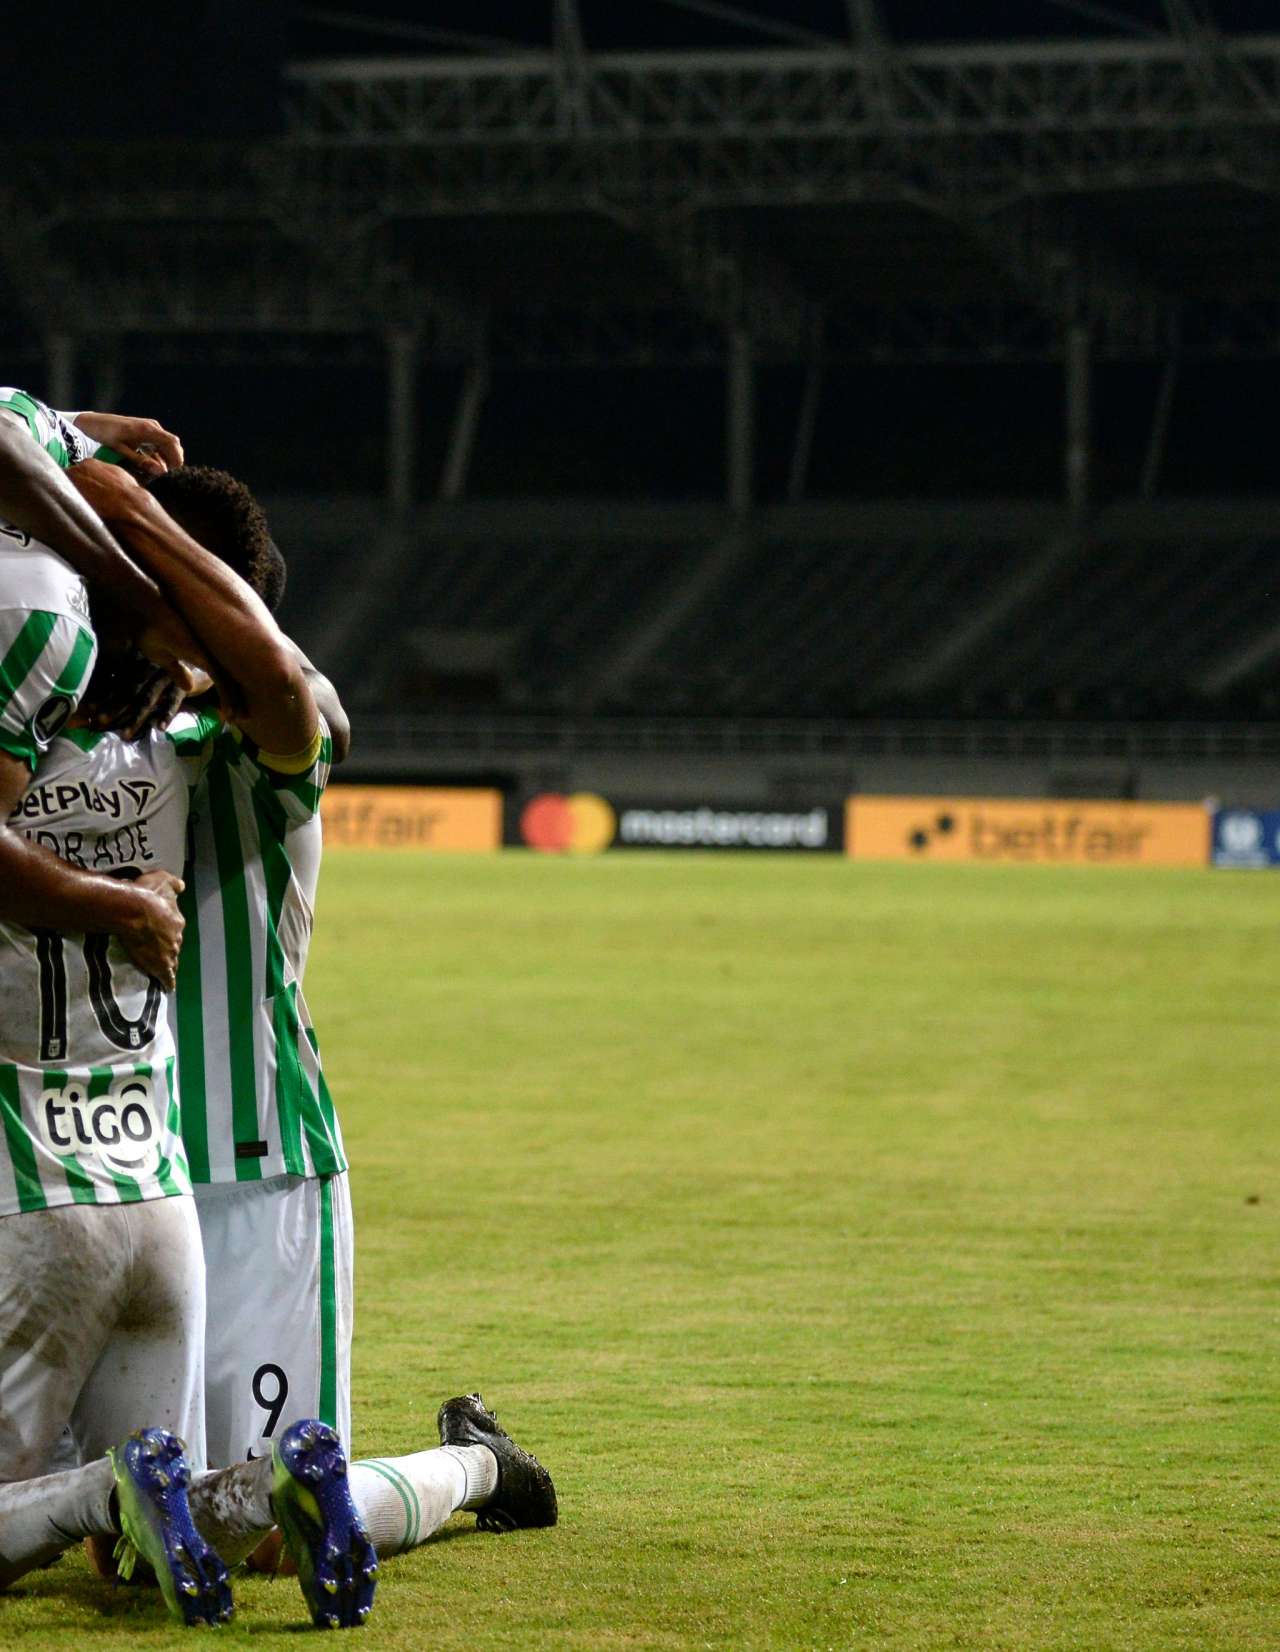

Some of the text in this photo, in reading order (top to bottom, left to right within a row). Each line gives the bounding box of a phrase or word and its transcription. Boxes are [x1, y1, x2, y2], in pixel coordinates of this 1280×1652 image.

[322, 807, 440, 845] tfair
[621, 808, 827, 847] mastercard
[970, 814, 1150, 860] betfair
[43, 1083, 154, 1147] tigo
[251, 1363, 289, 1438] 9
